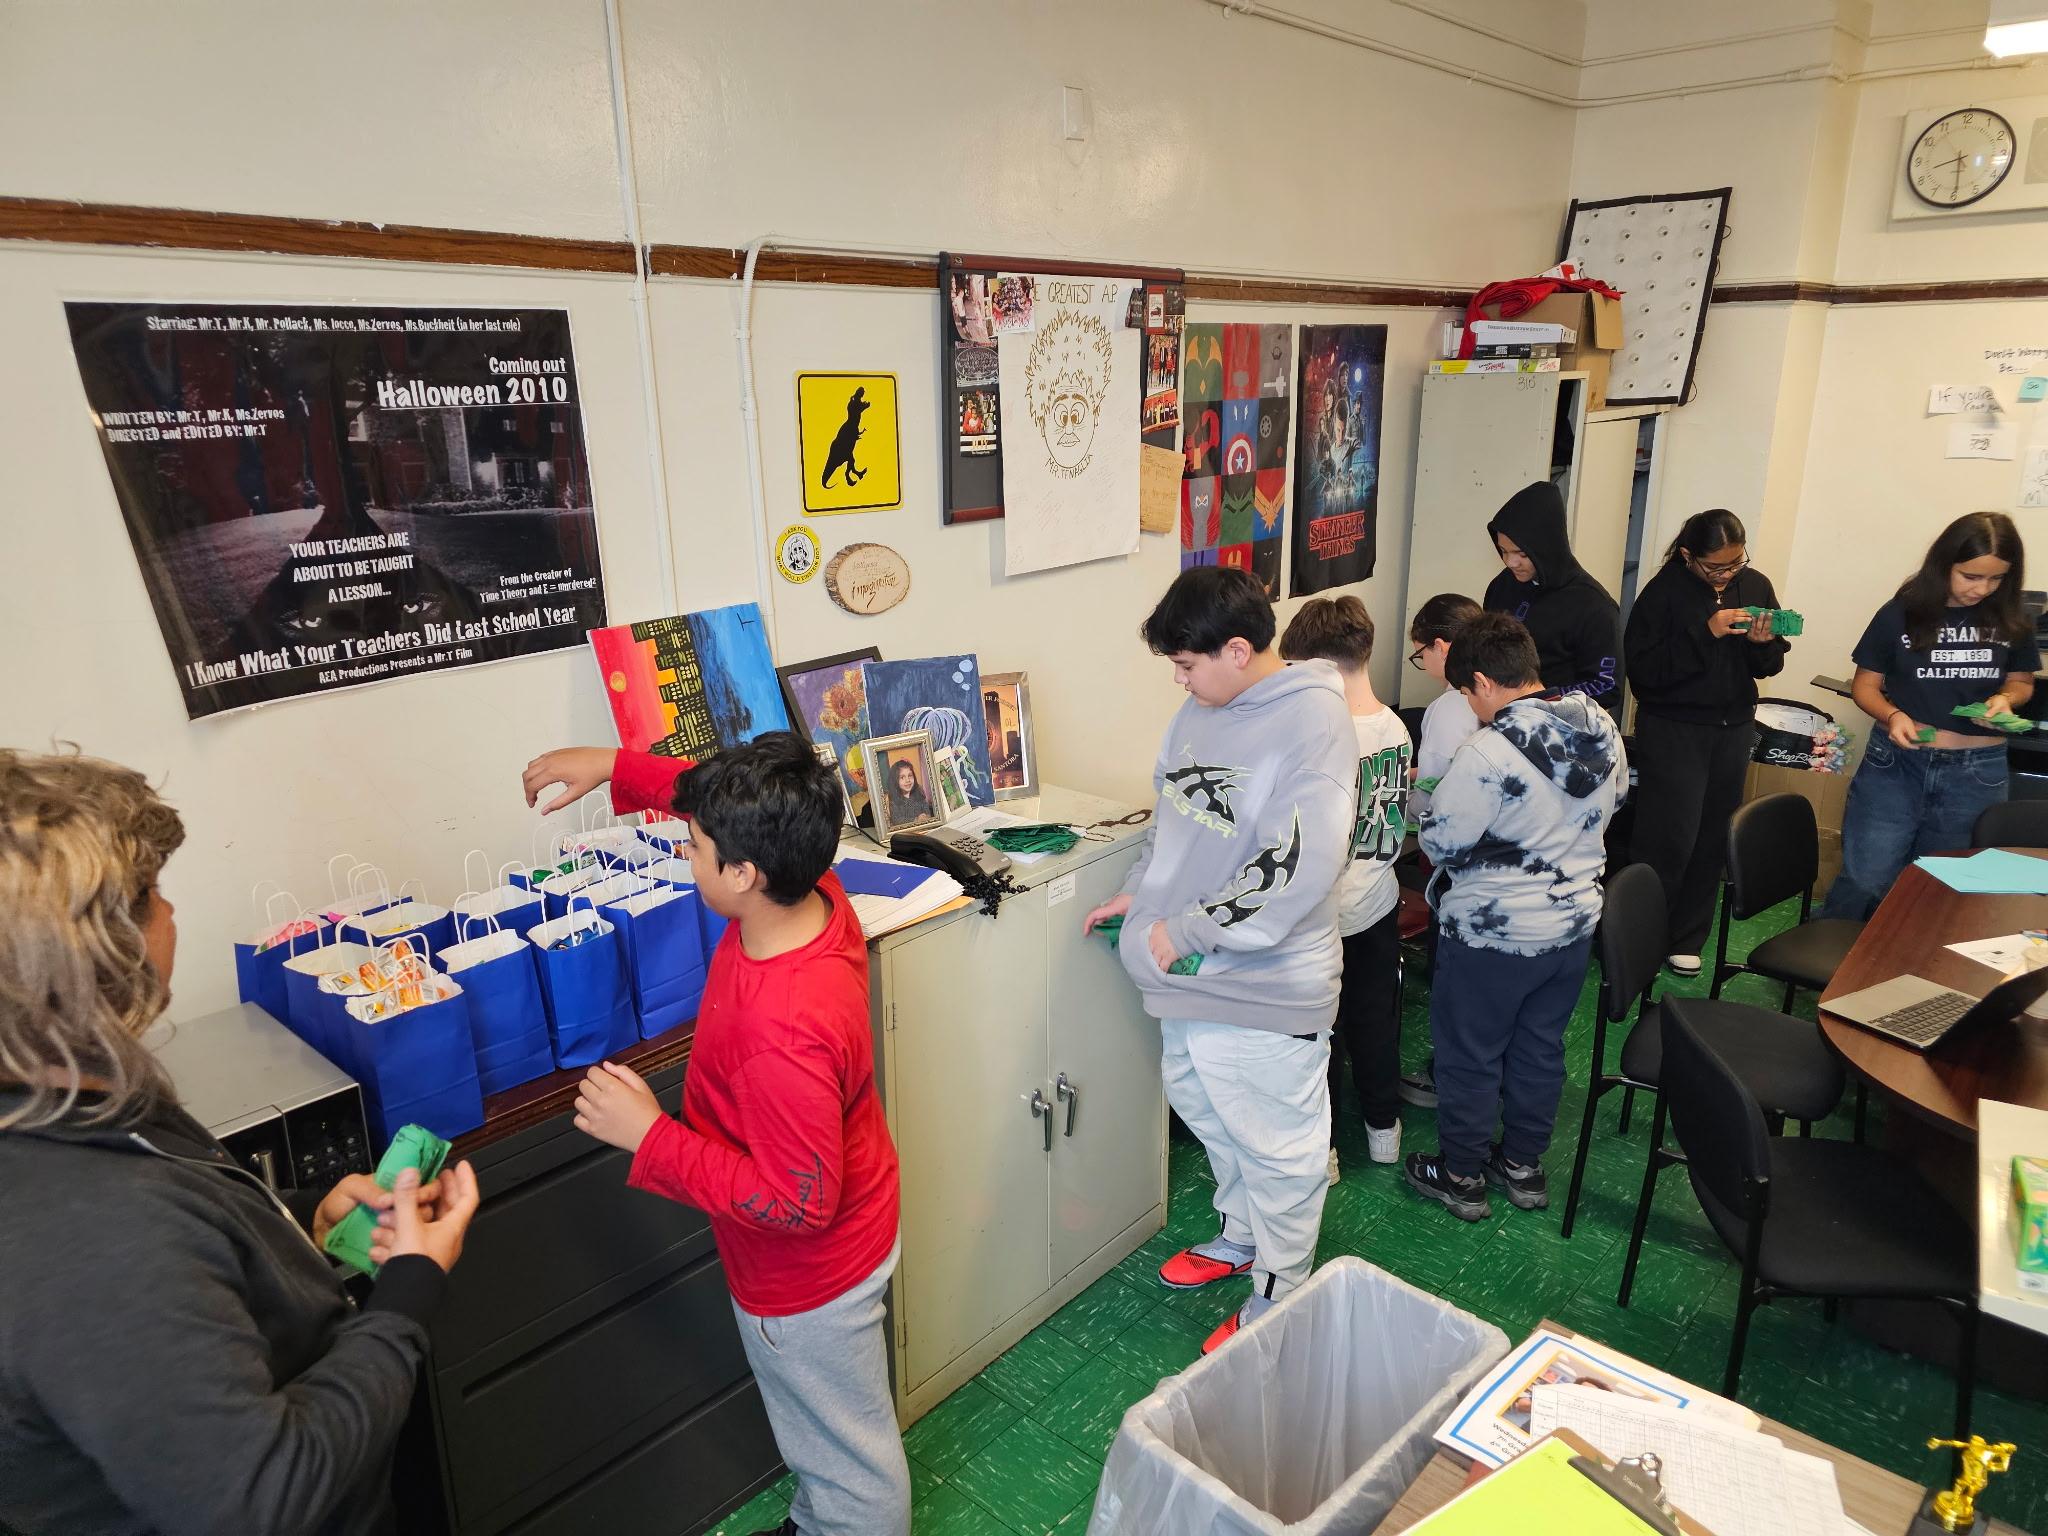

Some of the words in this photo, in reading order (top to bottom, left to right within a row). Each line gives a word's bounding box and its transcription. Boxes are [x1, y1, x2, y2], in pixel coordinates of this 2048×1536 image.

[1048, 281, 1095, 304] GREATEST
[146, 316, 198, 331] Starring:
[469, 318, 484, 331] her
[484, 318, 501, 331] last
[502, 317, 521, 331] role)
[489, 356, 540, 375] Coming
[542, 357, 566, 373] out
[377, 379, 501, 408] Halloween
[505, 376, 567, 404] 2010
[102, 410, 155, 426] WRITTEN
[156, 410, 176, 424] BY:
[106, 426, 160, 443] DIRECTED
[162, 426, 182, 441] and
[183, 424, 223, 440] EDITED
[225, 423, 243, 438] BY:
[1310, 512, 1365, 547] STRANGER
[289, 541, 326, 559] YOUR
[326, 534, 386, 556] TEACHERS
[387, 531, 410, 548] ARE
[1319, 537, 1356, 560] THINGS
[293, 566, 335, 583] ABOUT
[335, 562, 353, 578] TO
[355, 561, 371, 577] BE
[371, 554, 414, 574] TAUGHT
[500, 575, 520, 587] From
[520, 572, 533, 584] the
[534, 568, 563, 582] Creator
[563, 567, 572, 578] of
[328, 588, 338, 603] A
[339, 582, 392, 603] LESSON...
[479, 592, 500, 604] Time
[500, 588, 527, 601] Theory
[528, 584, 543, 596] and
[186, 664, 195, 687] I
[193, 658, 238, 685] Know
[240, 646, 292, 677] What
[294, 642, 338, 665] Your
[340, 629, 421, 659] Teachers
[424, 622, 452, 645] Did
[455, 616, 490, 641] Last
[492, 607, 540, 633] School
[544, 606, 576, 626] Year
[1963, 650, 1989, 662] 1850
[318, 670, 338, 684] AEA
[338, 661, 389, 680] Productions
[389, 655, 426, 671] Presents
[427, 654, 433, 664] a
[455, 648, 473, 660] Film
[1916, 667, 2000, 680] CALIFORNIA
